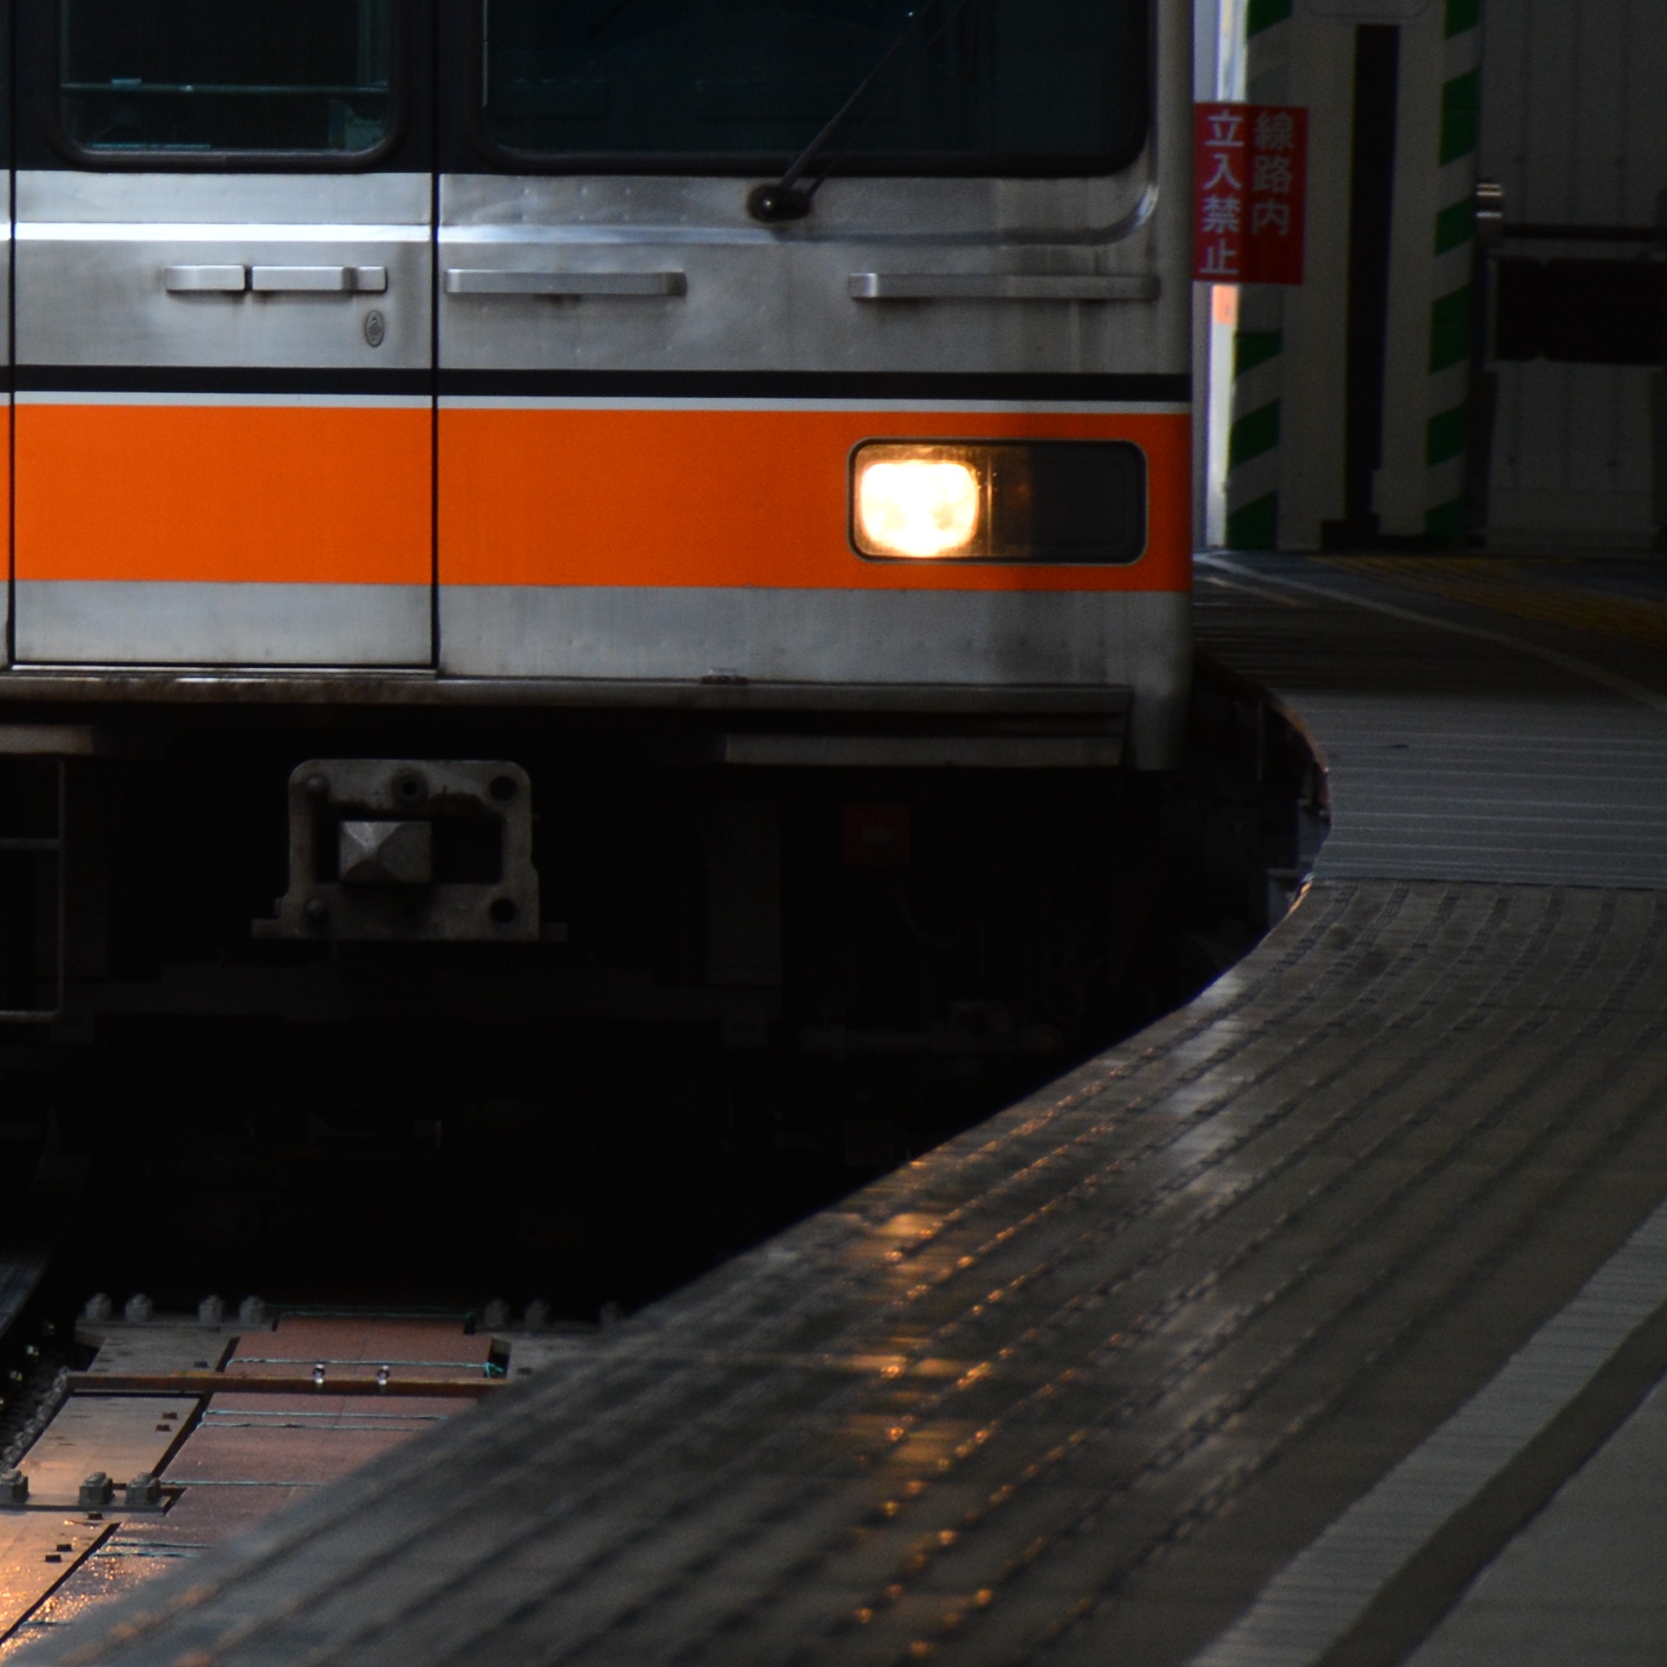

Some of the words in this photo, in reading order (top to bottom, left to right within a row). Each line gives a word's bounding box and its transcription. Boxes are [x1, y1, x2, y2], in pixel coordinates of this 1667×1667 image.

[1199, 109, 1245, 276] 立入禁止
[1251, 110, 1295, 237] 線路内
